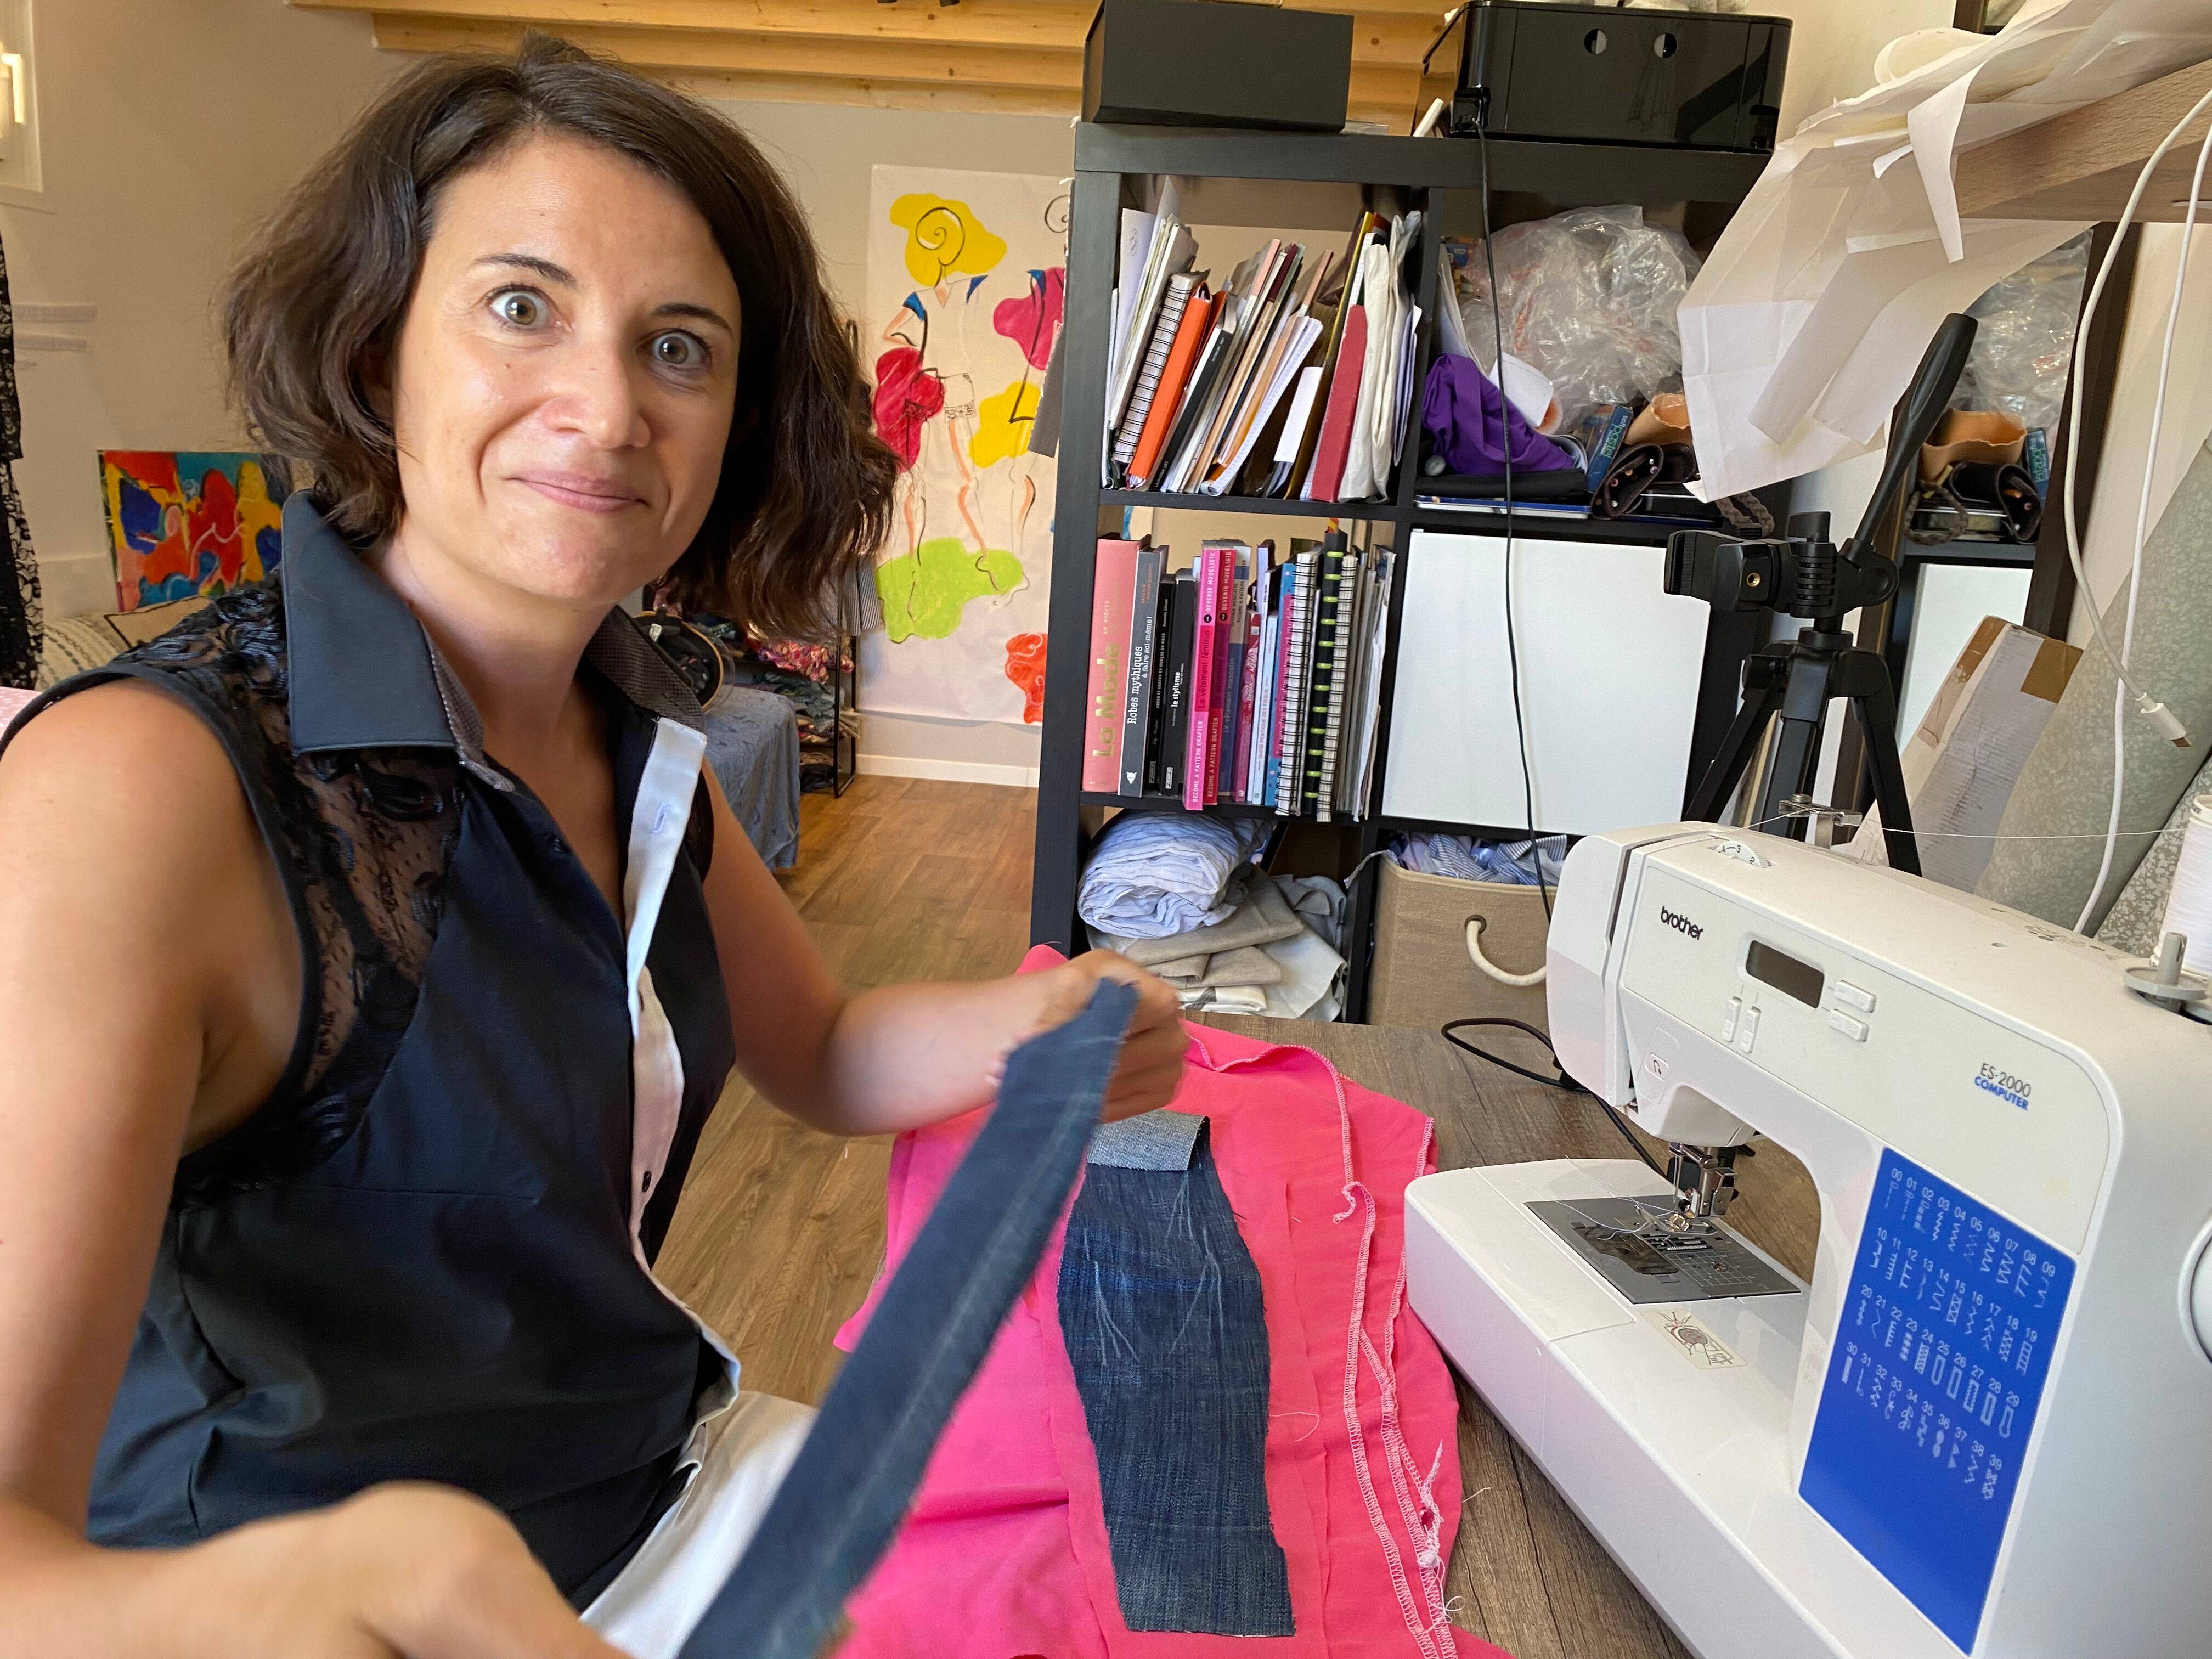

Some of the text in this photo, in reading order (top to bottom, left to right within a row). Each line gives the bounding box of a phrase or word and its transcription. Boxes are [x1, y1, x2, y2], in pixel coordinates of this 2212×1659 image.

[1207, 552, 1216, 584] MODELISTE
[1222, 551, 1231, 584] MODELISTE
[1127, 646, 1143, 724] Robes mythiques
[1172, 672, 1181, 699] stylisme
[1227, 658, 1235, 689] masculin
[1092, 644, 1121, 757] La Mode
[1661, 906, 1703, 940] brother
[1974, 1076, 2028, 1110] COMPUTER
[1980, 1063, 2031, 1097] ES-2000
[1892, 1168, 1903, 1181] 00
[1906, 1177, 1917, 1190] 01
[1922, 1187, 1934, 1201] 02
[1938, 1197, 1949, 1210] 03
[1954, 1207, 1966, 1221] 04
[1971, 1217, 1983, 1231] 05
[2006, 1239, 2018, 1252] 07
[2024, 1250, 2036, 1265] 08
[1878, 1228, 2037, 1342] 10 11 12 13 14 15 16 17 18 19
[1876, 1295, 1886, 1308] 21
[1922, 1329, 1933, 1343] 24
[1972, 1365, 1984, 1379] 27
[1989, 1378, 2001, 1393] 28
[1906, 1389, 1917, 1404] 34
[1922, 1401, 1933, 1416] 35
[1938, 1414, 1950, 1429] 36
[1955, 1427, 1967, 1441] 37
[1972, 1441, 1984, 1456] 38
